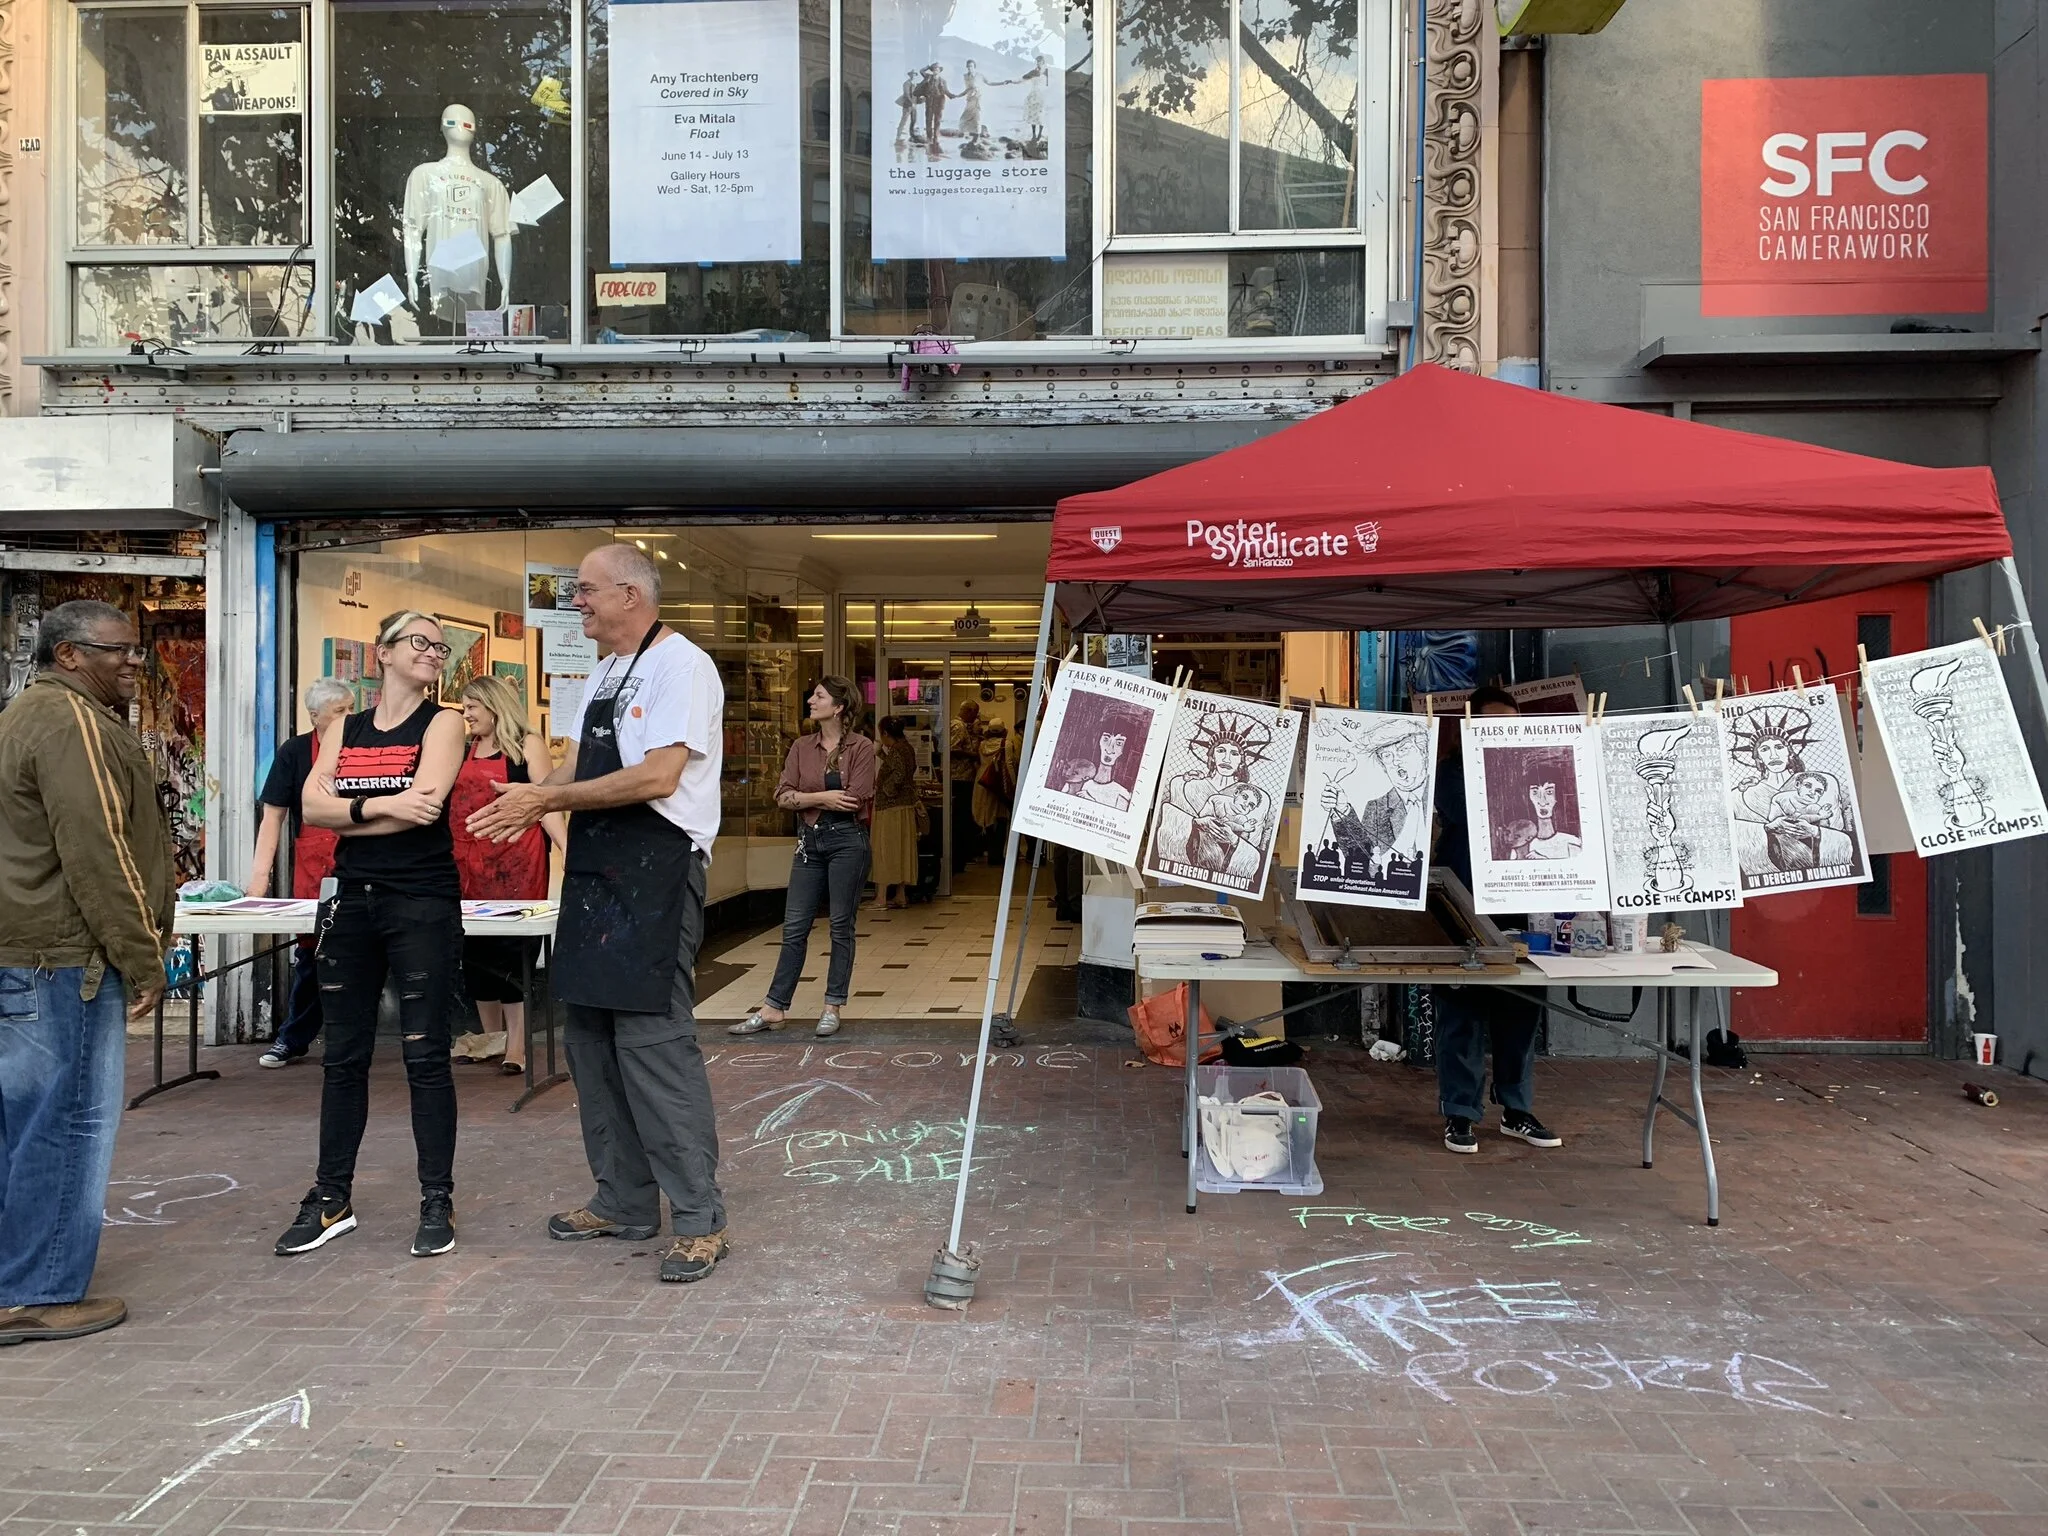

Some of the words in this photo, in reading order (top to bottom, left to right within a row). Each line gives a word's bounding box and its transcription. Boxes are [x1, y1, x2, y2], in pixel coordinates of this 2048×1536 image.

[205, 48, 231, 60] BAN
[235, 46, 292, 60] ASSAULT
[650, 73, 677, 86] Amy
[680, 71, 759, 84] Trachtenberg
[660, 87, 710, 99] Covered
[713, 87, 724, 98] in
[727, 86, 749, 99] Sky
[232, 96, 296, 110] WEAPONS!
[674, 113, 696, 124] Eva
[699, 113, 736, 124] Mitala
[689, 128, 720, 139] Float
[20, 138, 41, 151] LEAD
[661, 151, 687, 162] June
[690, 150, 702, 160] 14
[712, 150, 733, 162] July
[736, 149, 749, 159] 13
[1759, 129, 1929, 198] SFC
[670, 170, 707, 182] Gallery
[709, 170, 741, 181] Hours
[888, 168, 916, 179] the
[926, 167, 992, 180] luggage
[1001, 166, 1049, 178] store
[657, 184, 681, 195] Wed
[690, 184, 711, 195] Sat,
[714, 183, 754, 195] 12-5pm
[888, 185, 1048, 197] www.luggagestoregallery.org
[1759, 205, 1800, 232] SAN
[1810, 203, 1930, 231] FRANCISCO
[1759, 233, 1929, 261] CAMERAWORK
[600, 281, 657, 298] FOREVER
[1103, 327, 1153, 336] OFFICE
[1157, 326, 1176, 336] OF
[1181, 325, 1224, 337] IDEAS
[1094, 529, 1118, 538] QUEST
[1186, 518, 1277, 547] Poster
[1210, 531, 1349, 567] Syndicate
[1243, 556, 1259, 568] San
[1258, 555, 1294, 567] Francisco
[954, 619, 979, 630] 1009
[1067, 669, 1097, 683] TALES
[1100, 676, 1112, 686] OF
[1113, 678, 1170, 702] MIGRATION
[1540, 679, 1577, 692] MIGRATION
[1184, 698, 1217, 714] ASILO
[1417, 695, 1439, 705] TAES
[1440, 695, 1448, 703] OF
[1450, 694, 1471, 702] MIGRA
[1809, 694, 1826, 707] ES
[1276, 717, 1291, 729] ES
[1340, 716, 1362, 730] STOP
[1472, 726, 1504, 737] TALES
[1507, 725, 1520, 736] OF
[1523, 723, 1583, 735] MIGRATION
[1315, 753, 1348, 763] America
[1920, 829, 1967, 849] CLOSE
[1968, 827, 1987, 838] THE
[1988, 814, 2044, 835] CAMPS!
[1158, 859, 1171, 872] UN
[1172, 862, 1210, 881] DERECHO
[1211, 870, 1250, 891] HUMANO!
[1312, 874, 1329, 883] STOP
[1330, 876, 1345, 884] unfair
[1345, 878, 1376, 887] deportations
[1748, 875, 1761, 888] UN
[1762, 869, 1804, 887] DERECHO
[1806, 864, 1852, 881] HUMANO!
[1343, 883, 1369, 892] Southeast
[1381, 887, 1410, 896] Americans!
[1616, 893, 1662, 908] CLOSE
[1664, 894, 1682, 903] THE
[1684, 889, 1736, 904] CAMPS!
[704, 1045, 1091, 1069] elcome
